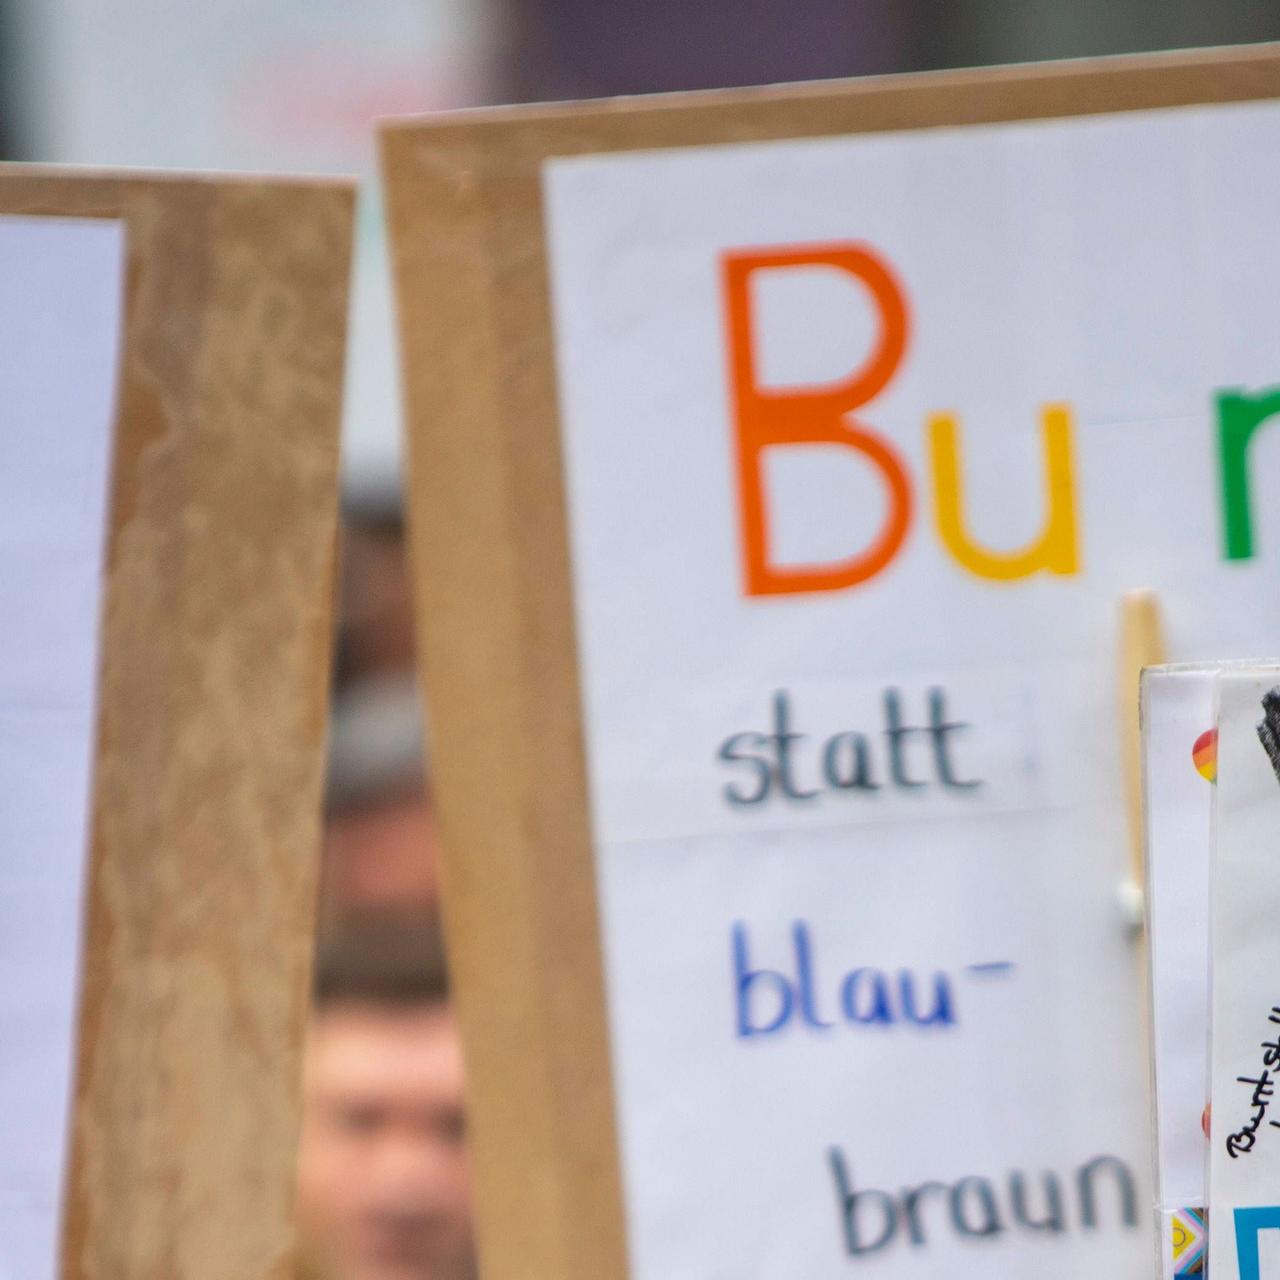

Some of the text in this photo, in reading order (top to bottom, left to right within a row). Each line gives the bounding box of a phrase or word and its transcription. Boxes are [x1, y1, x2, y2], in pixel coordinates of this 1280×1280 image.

[716, 686, 984, 806] statt
[730, 917, 1016, 1040] blau-
[826, 1144, 1140, 1259] braun
